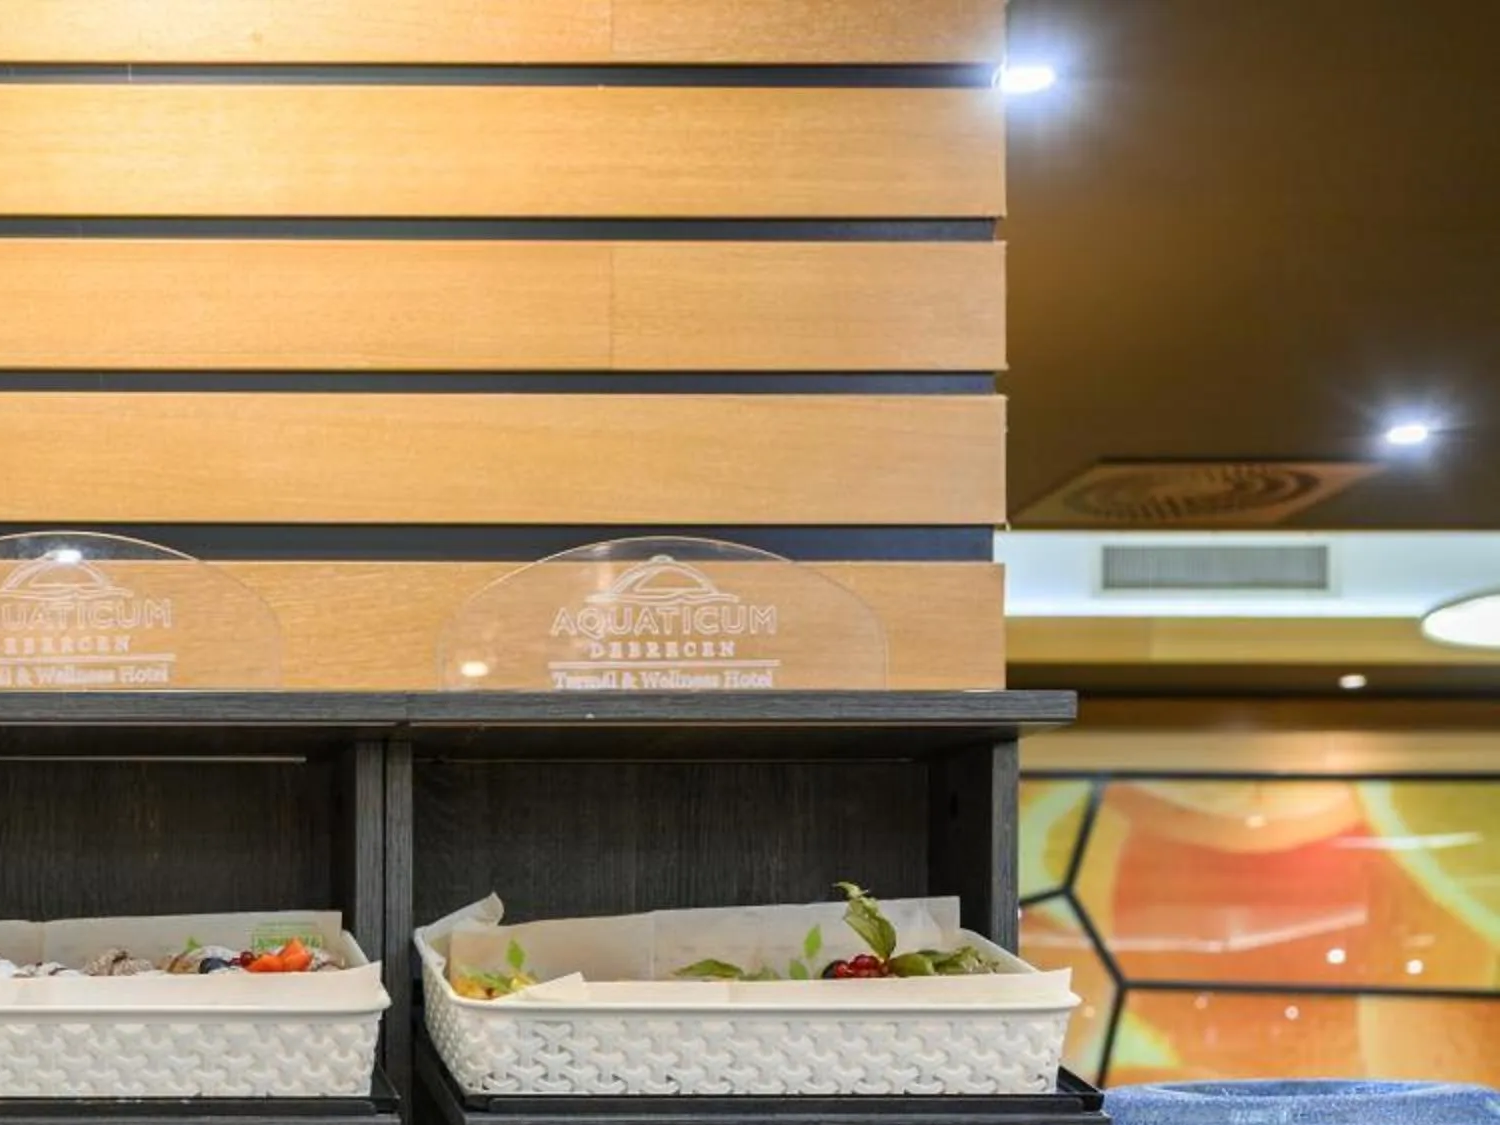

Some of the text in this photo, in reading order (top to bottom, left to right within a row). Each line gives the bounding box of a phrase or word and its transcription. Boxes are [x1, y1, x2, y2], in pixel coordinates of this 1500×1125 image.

[551, 605, 777, 640] AQUATICUM
[589, 640, 735, 658] DEBRECEN
[119, 663, 169, 683] Hotel
[723, 669, 773, 688] Hotel
